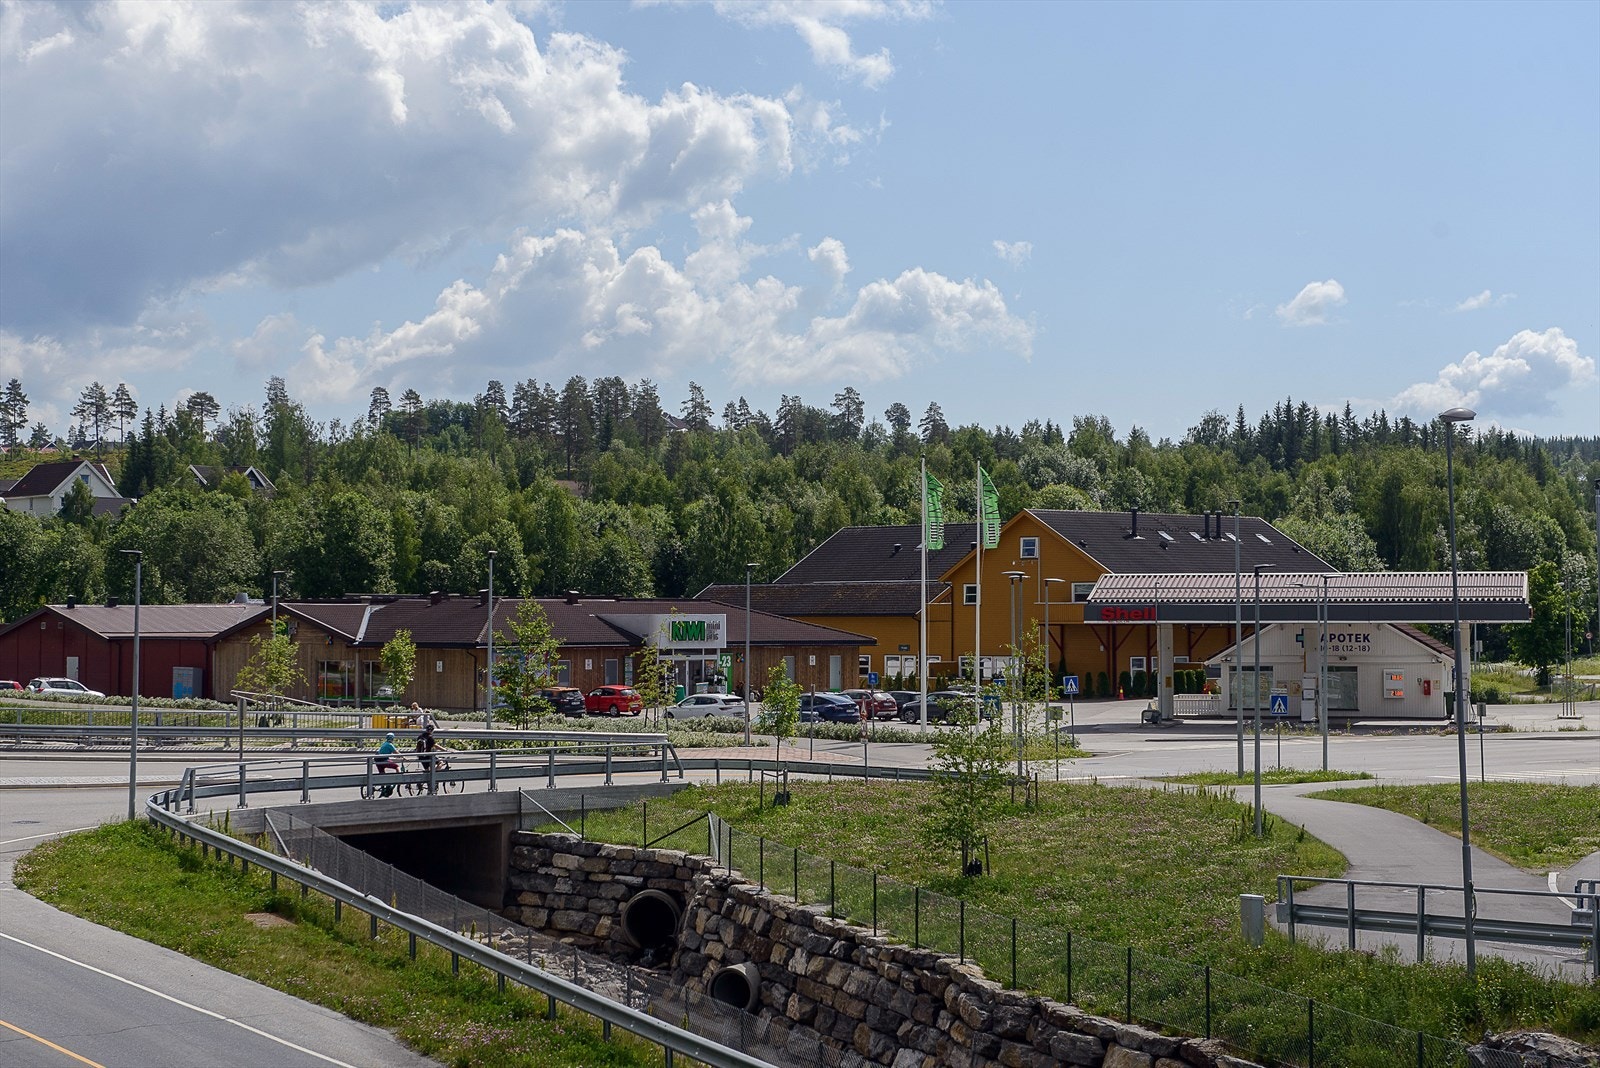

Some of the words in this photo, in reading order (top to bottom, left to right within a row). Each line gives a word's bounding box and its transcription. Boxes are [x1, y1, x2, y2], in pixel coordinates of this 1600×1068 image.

[1102, 607, 1156, 620] Shell
[671, 621, 706, 641] KIWI
[1341, 645, 1371, 653] (12-18)
